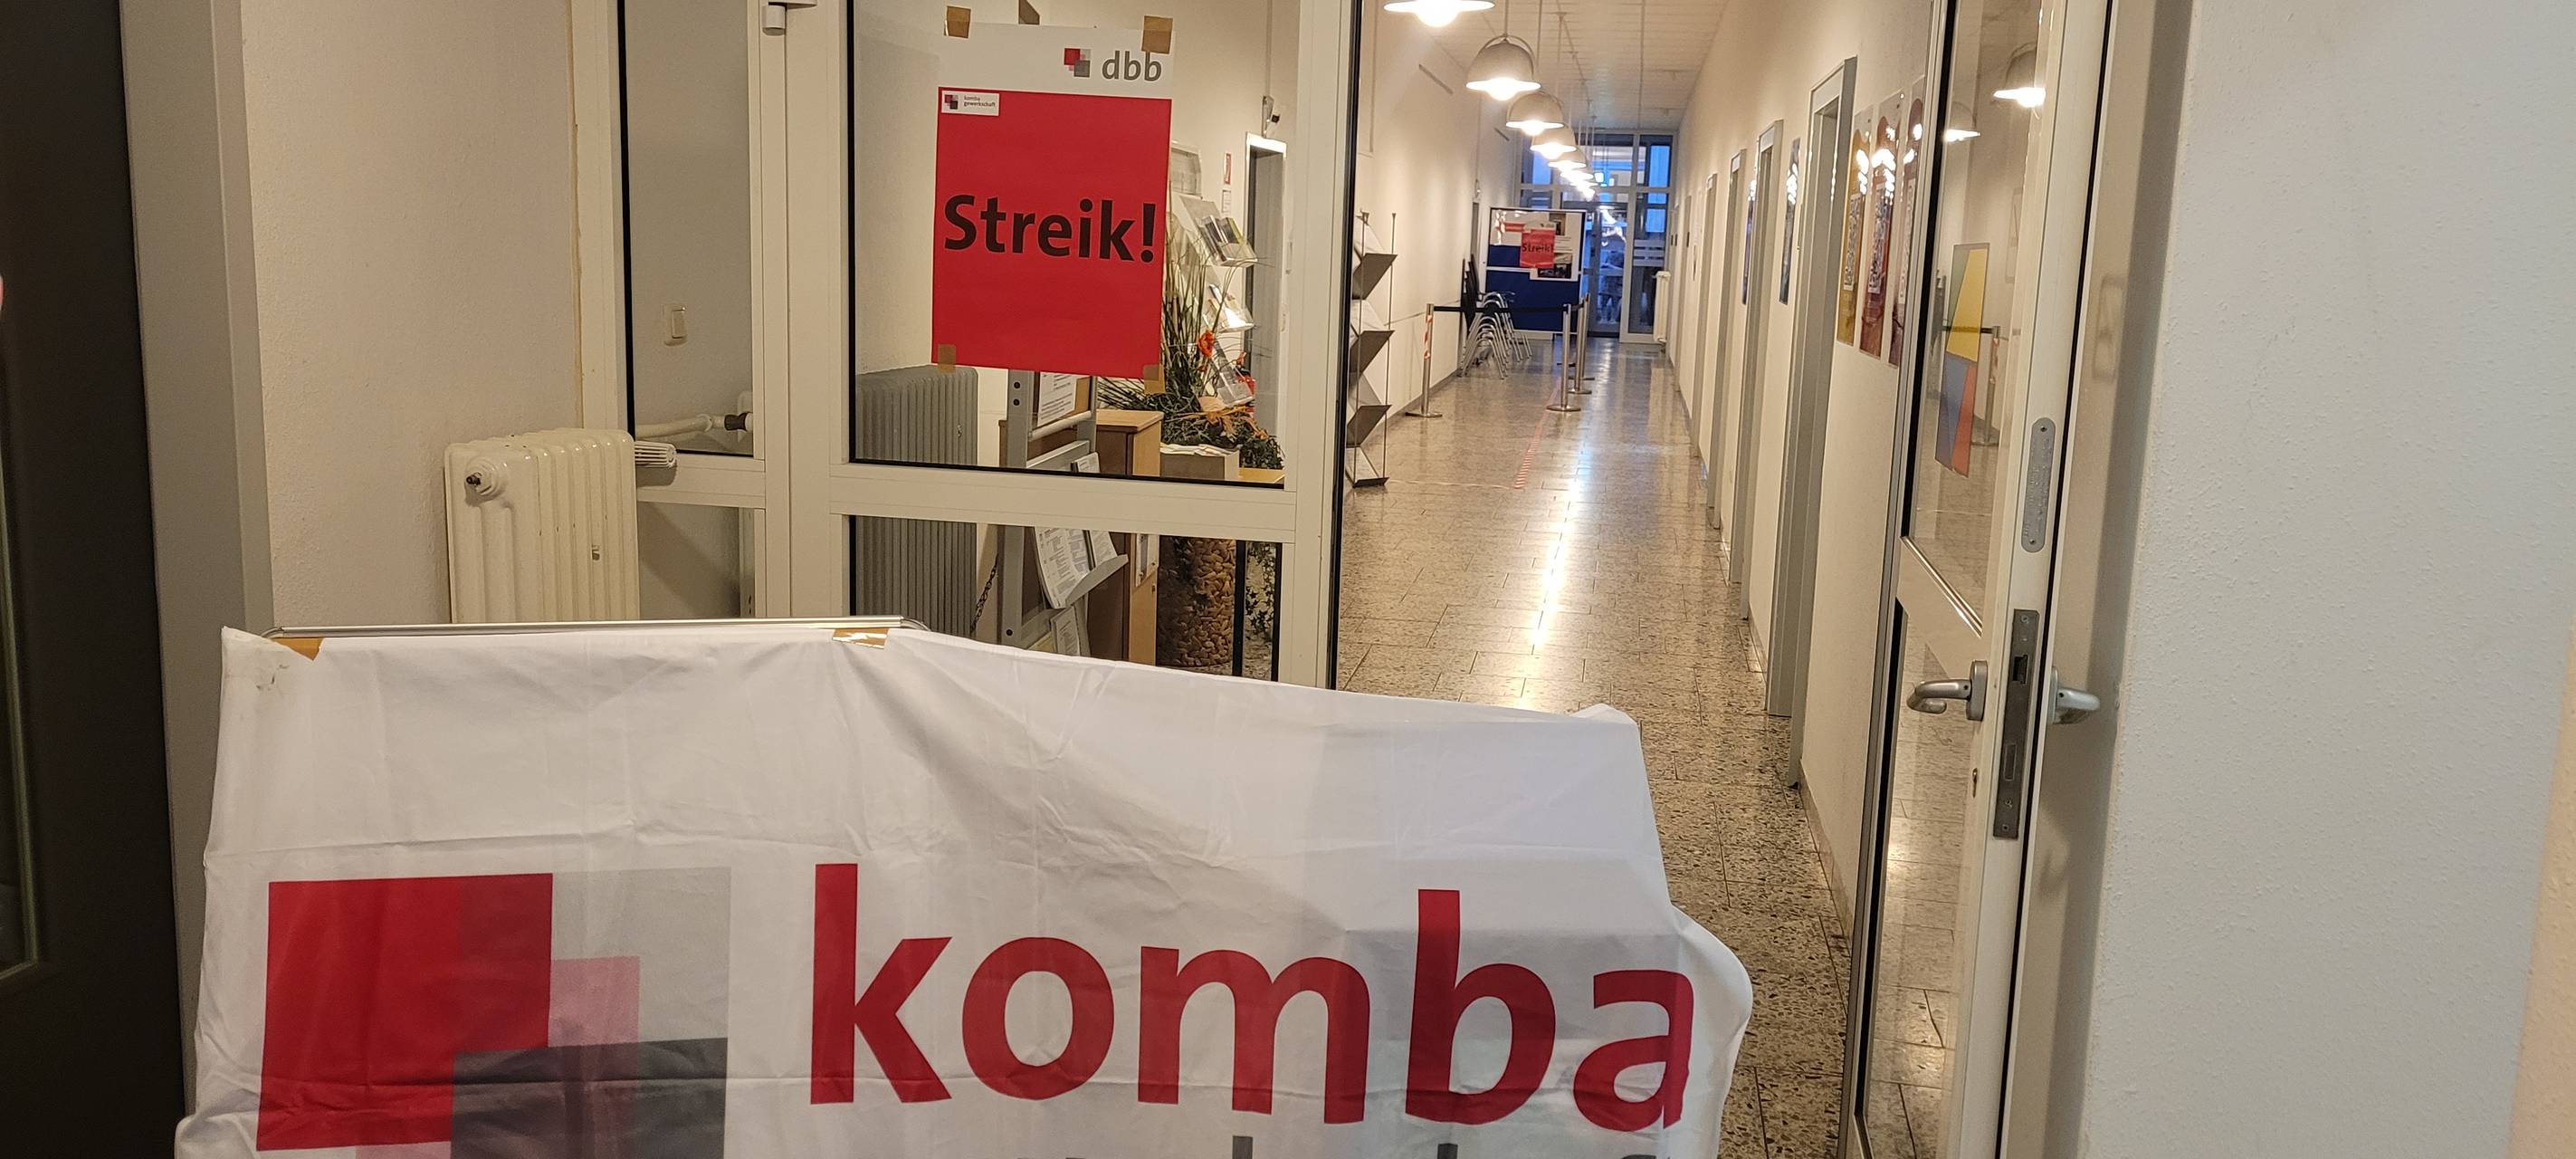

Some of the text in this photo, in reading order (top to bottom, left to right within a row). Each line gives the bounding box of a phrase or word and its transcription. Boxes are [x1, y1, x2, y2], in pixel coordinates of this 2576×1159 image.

[1102, 51, 1162, 81] dbb
[944, 195, 1157, 263] Streik!
[809, 862, 1695, 1133] komba
